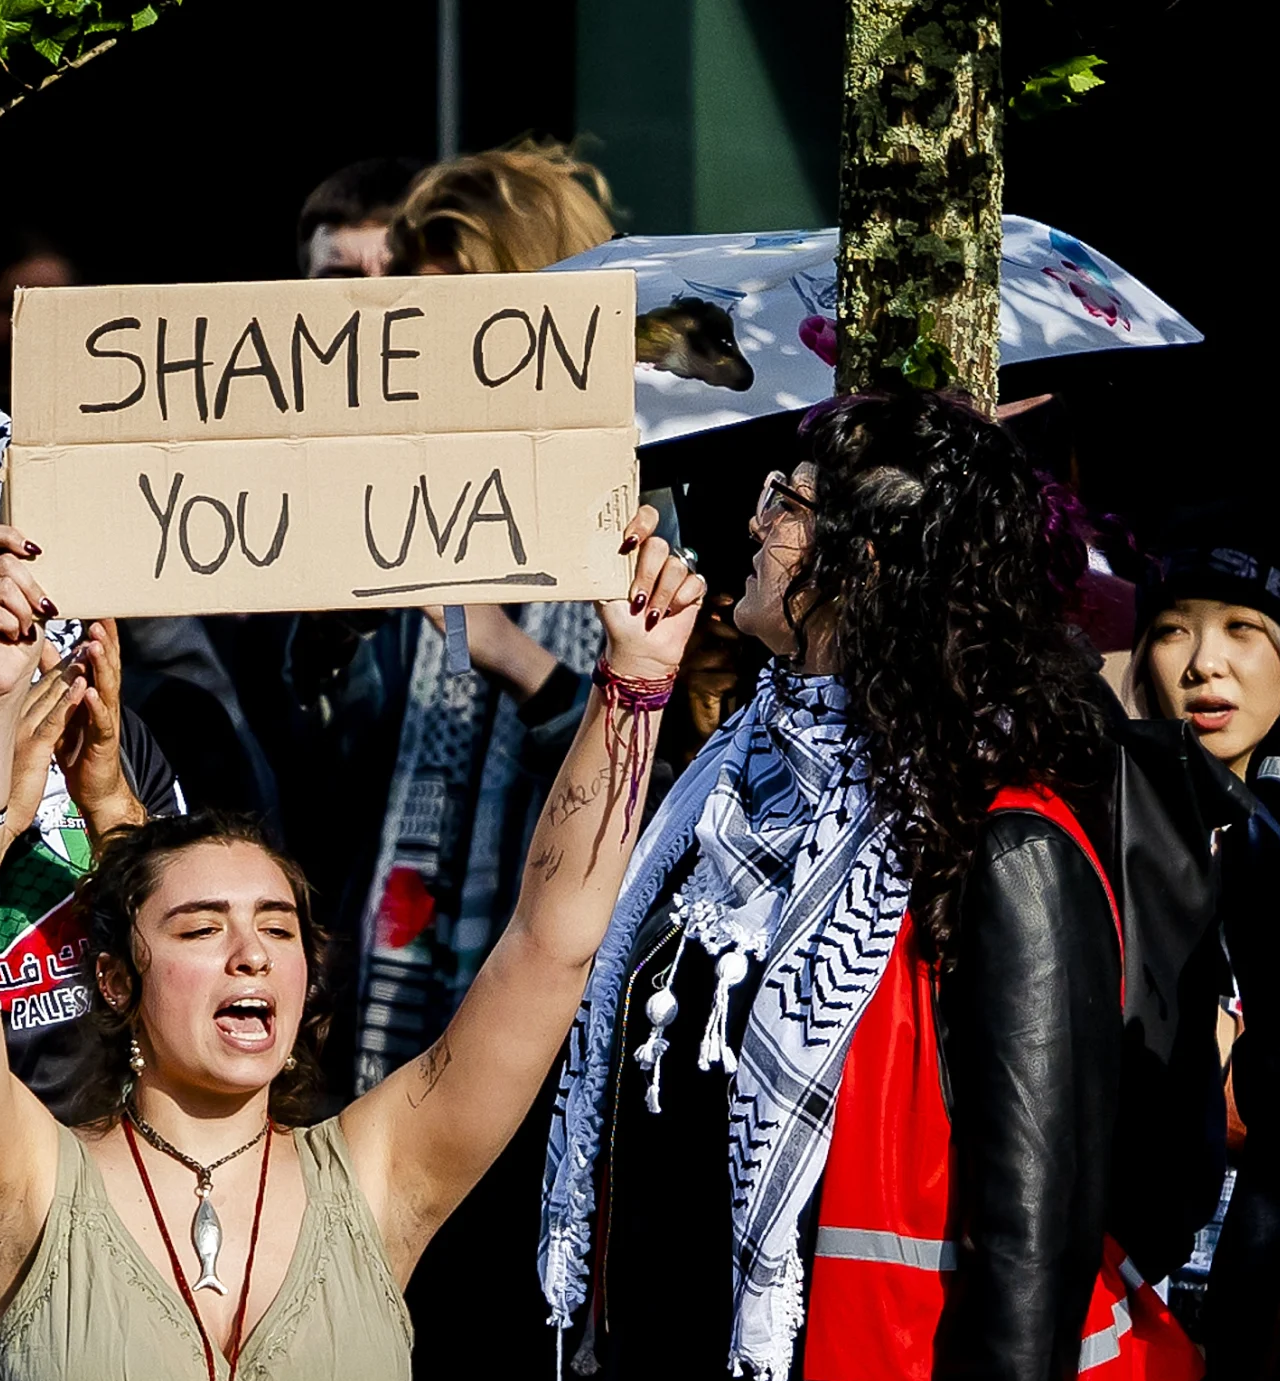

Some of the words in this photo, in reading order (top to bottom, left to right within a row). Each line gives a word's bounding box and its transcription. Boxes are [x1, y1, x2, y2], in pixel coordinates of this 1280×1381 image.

[79, 306, 425, 424] SHAME
[472, 304, 600, 392] ON
[138, 472, 289, 579] YOU
[364, 468, 526, 571] UVA
[11, 986, 92, 1031] PALES
